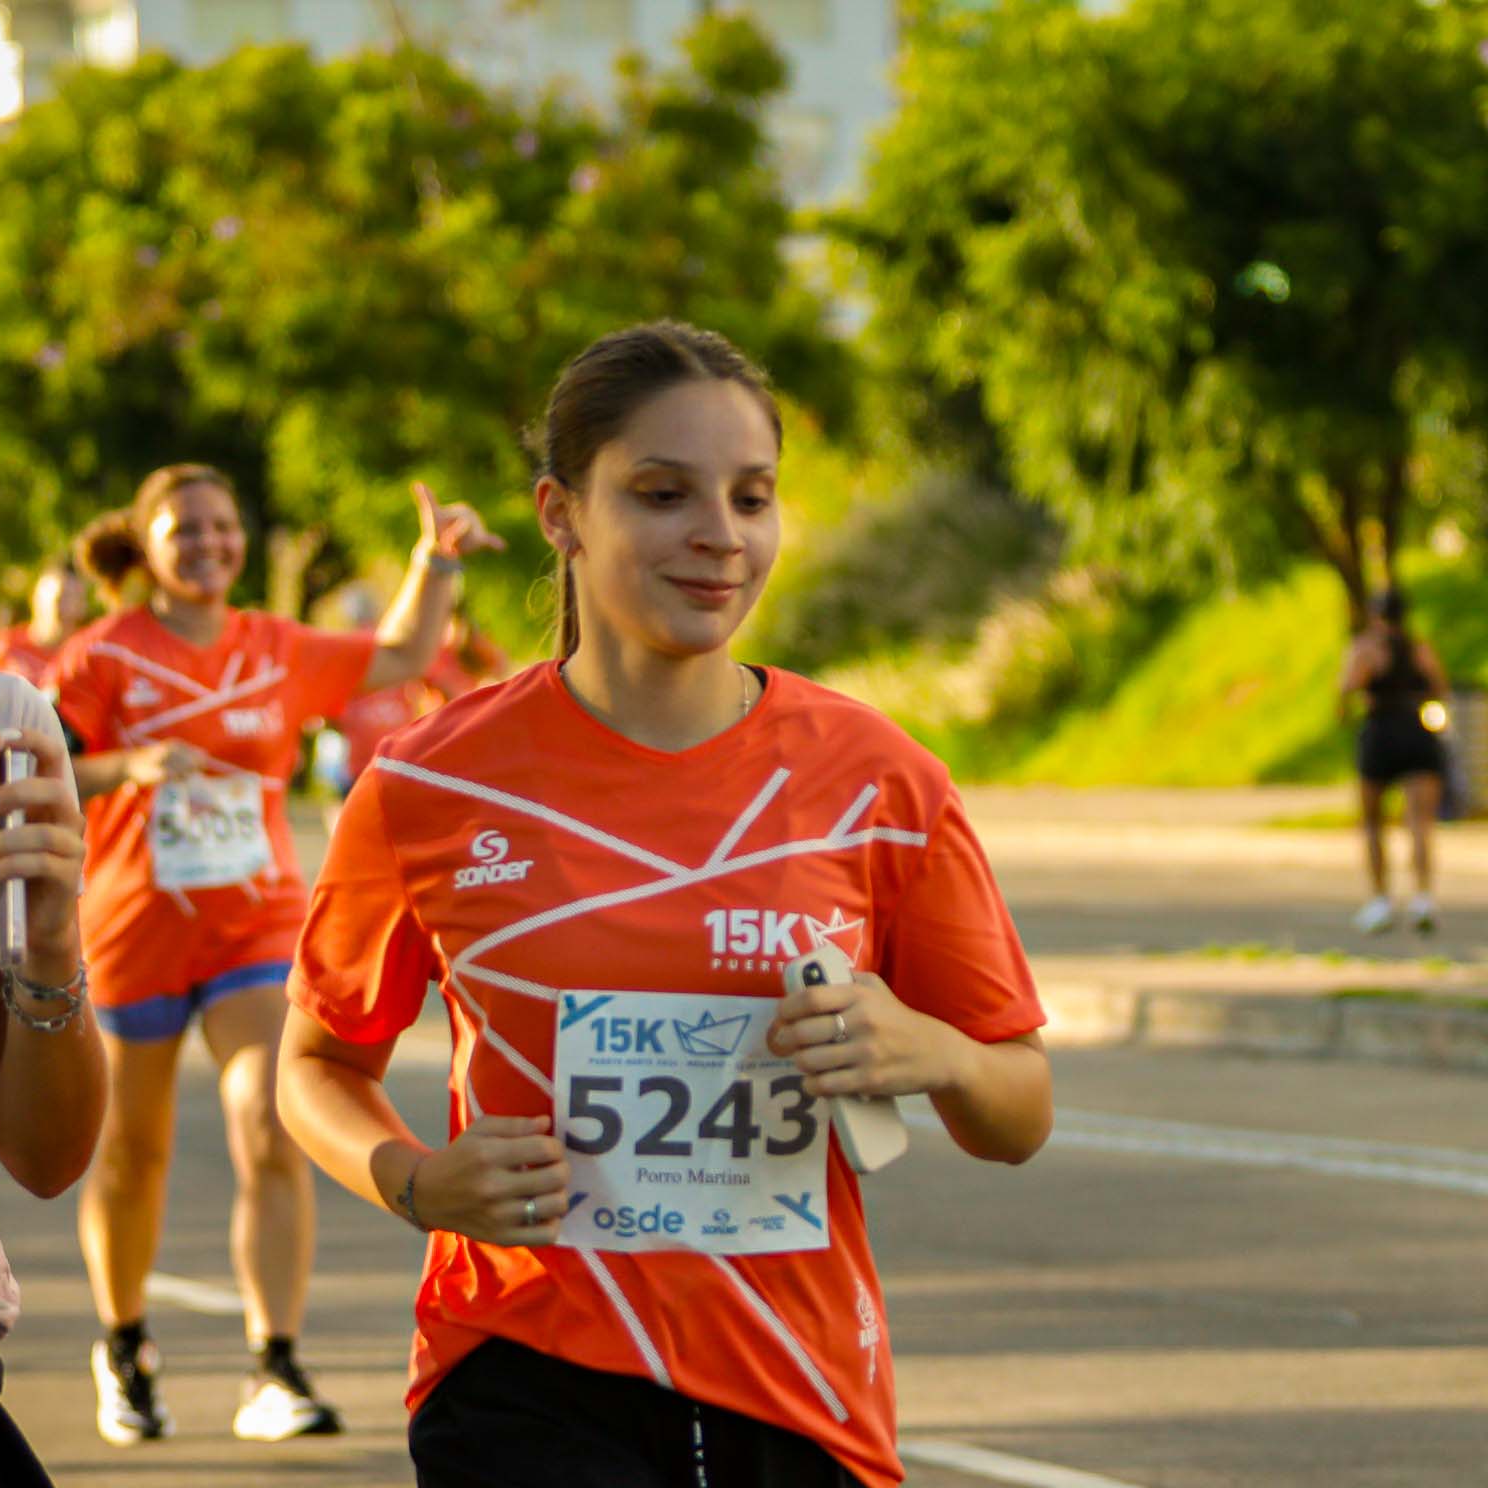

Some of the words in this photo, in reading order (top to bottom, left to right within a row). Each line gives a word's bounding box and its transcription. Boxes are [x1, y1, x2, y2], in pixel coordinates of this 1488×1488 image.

[704, 909, 800, 957] 15K
[712, 958, 786, 973] PUERT
[590, 1018, 666, 1052] 15K
[565, 1073, 818, 1158] 5243
[687, 1167, 751, 1184] Martina
[594, 1203, 684, 1237] osde
